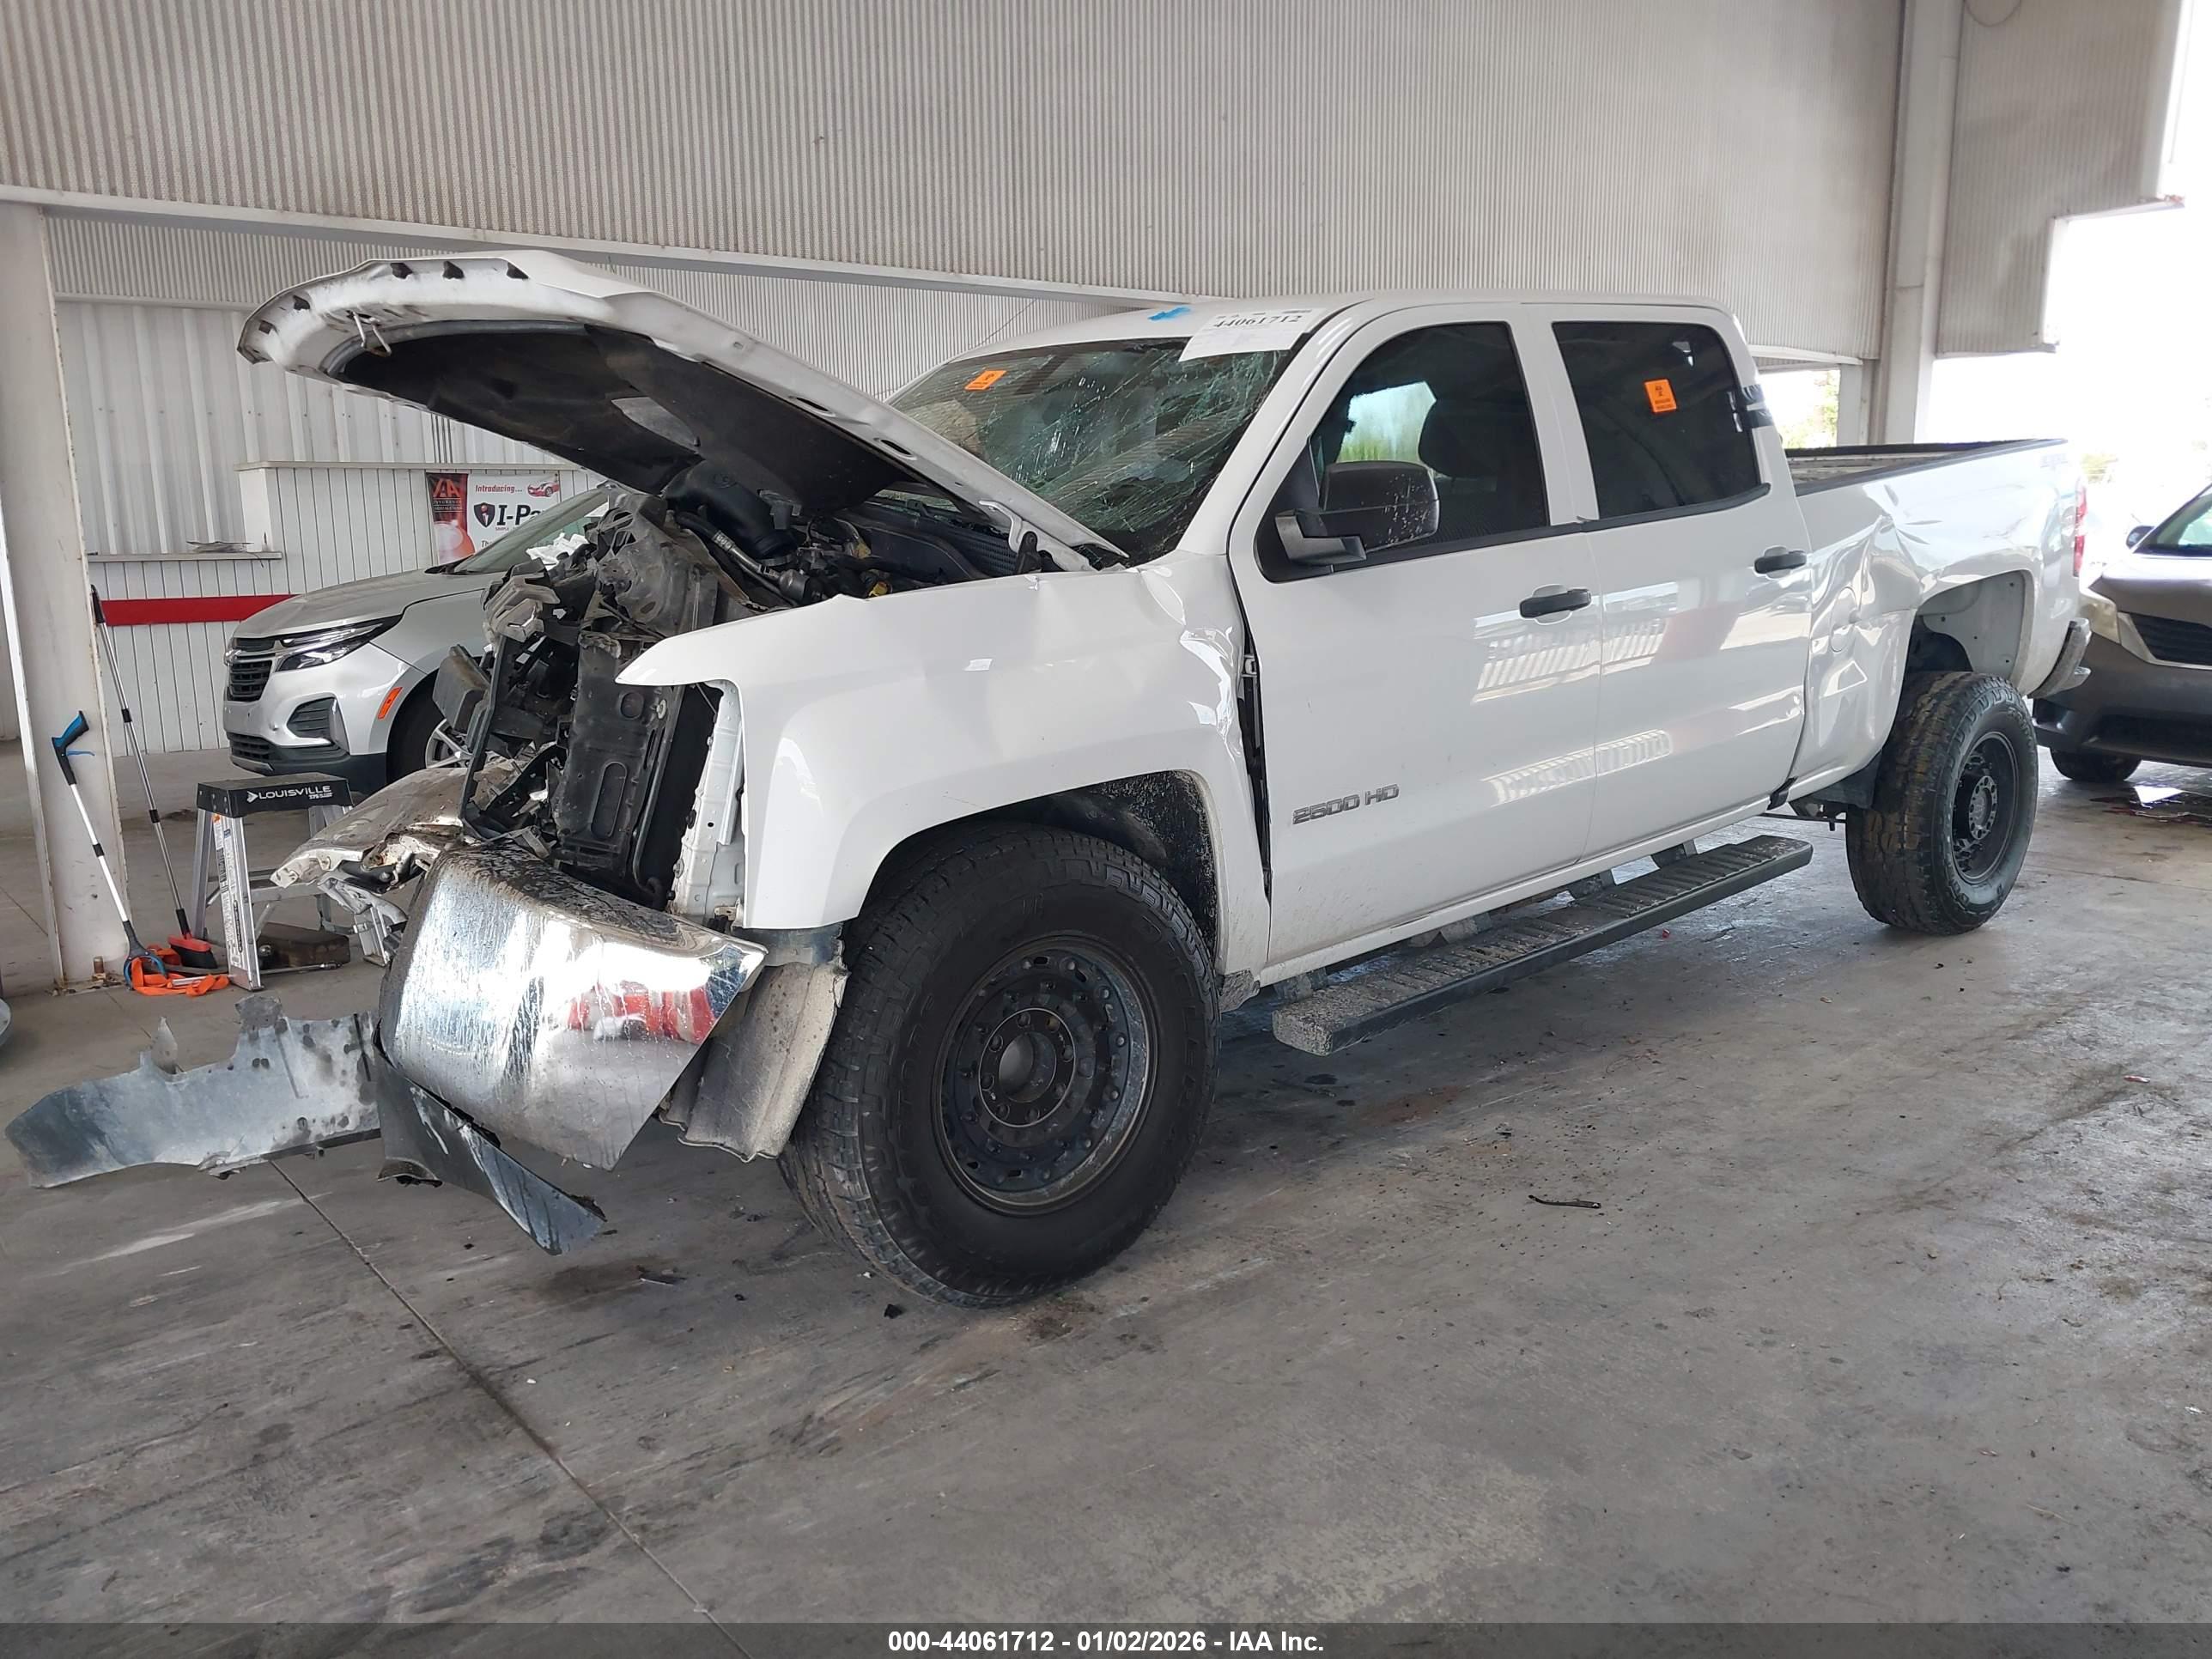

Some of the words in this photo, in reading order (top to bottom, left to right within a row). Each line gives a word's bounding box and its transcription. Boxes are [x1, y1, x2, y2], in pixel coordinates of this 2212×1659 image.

[1213, 315, 1302, 327] 44061712
[258, 786, 331, 799] LOUISVILLE
[1292, 794, 1360, 824] 2500
[1365, 784, 1399, 805] HD
